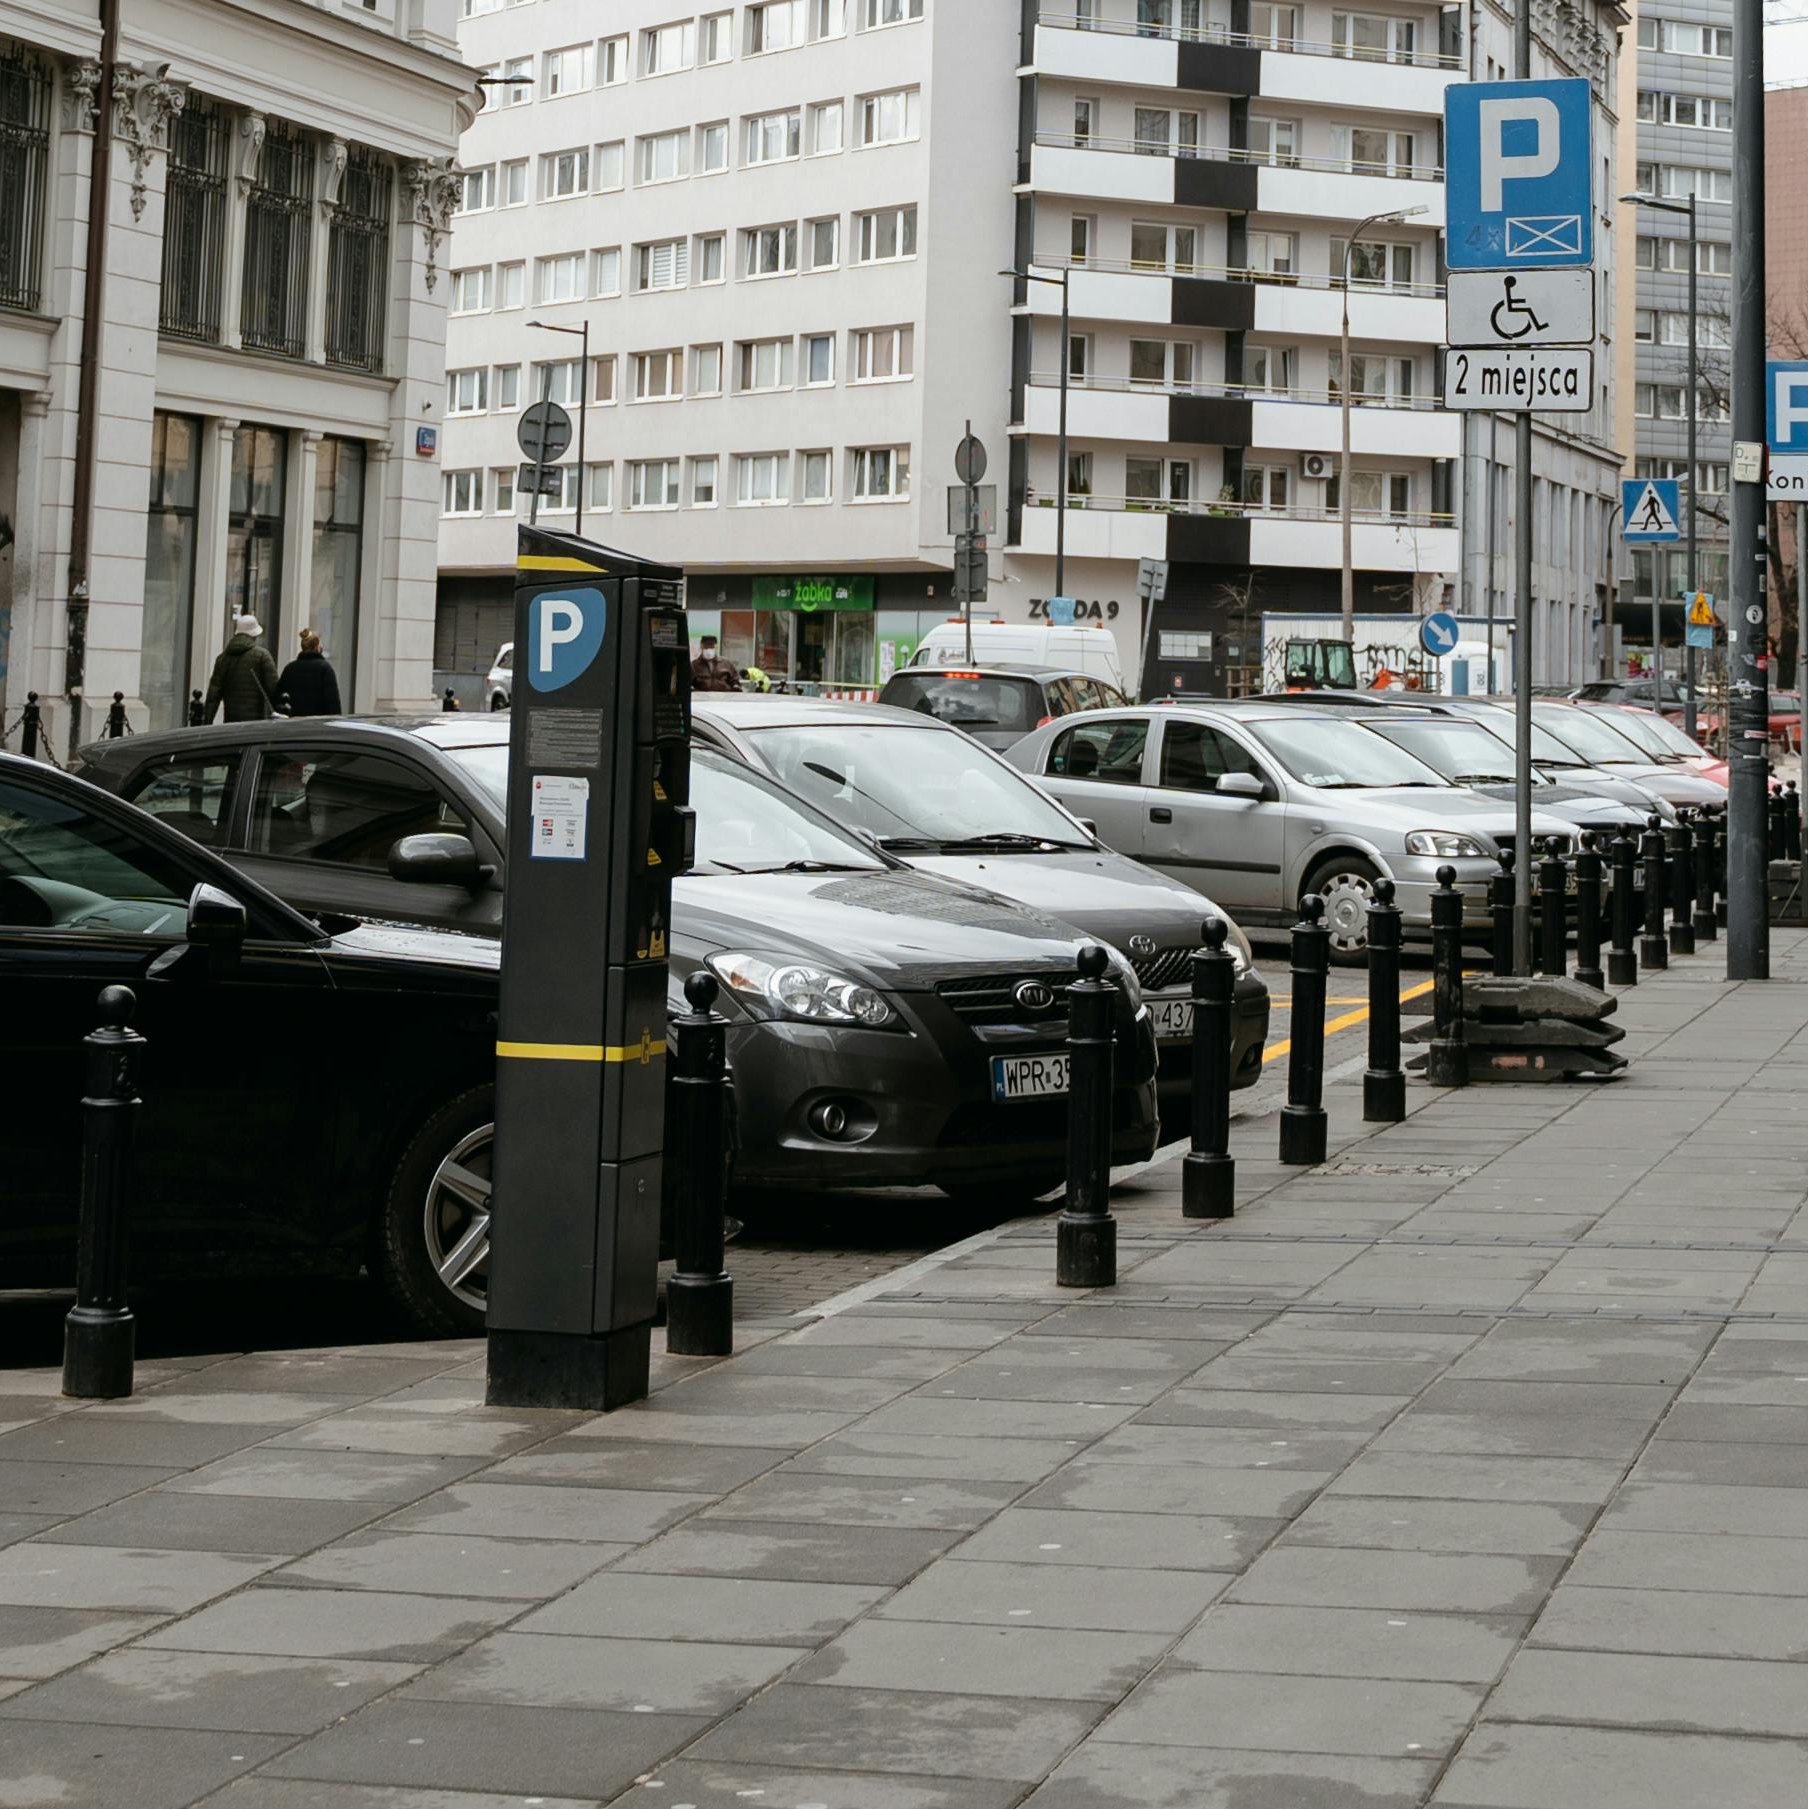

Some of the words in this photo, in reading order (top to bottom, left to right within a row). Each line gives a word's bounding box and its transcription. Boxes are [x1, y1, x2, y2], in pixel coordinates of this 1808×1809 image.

[1480, 97, 1560, 212] P
[1455, 354, 1469, 395] 2
[1481, 354, 1579, 407] miejsca
[794, 580, 832, 601] żabka
[1107, 600, 1119, 620] 9
[539, 600, 584, 672] P
[1006, 1060, 1045, 1094] WPR
